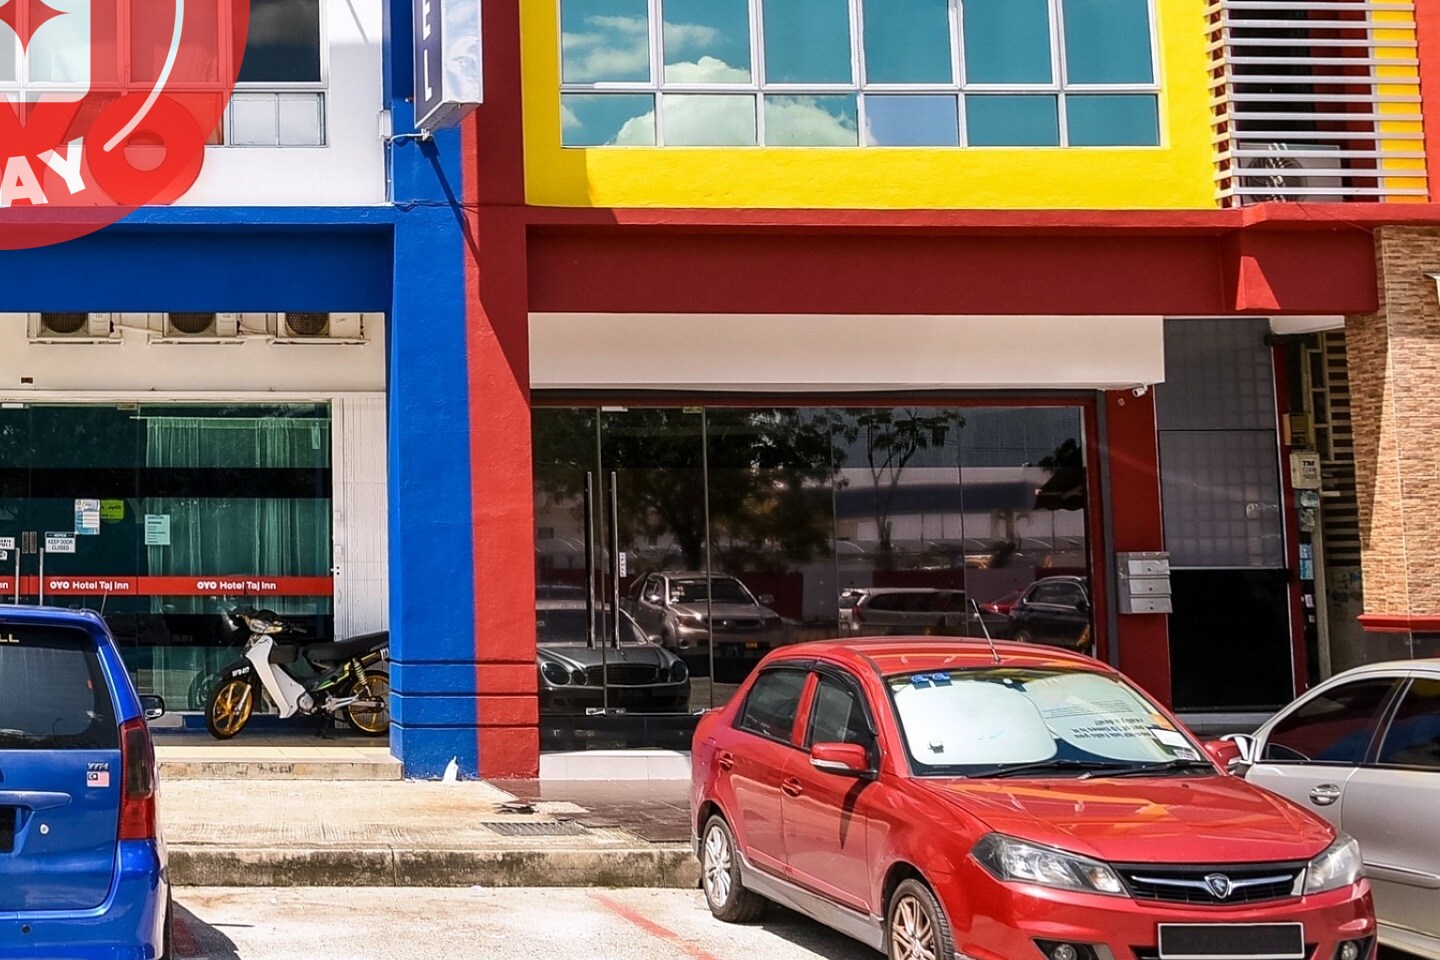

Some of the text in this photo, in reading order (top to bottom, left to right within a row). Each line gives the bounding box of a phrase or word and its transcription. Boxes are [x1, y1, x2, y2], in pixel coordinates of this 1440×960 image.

[49, 581, 129, 591] OYO Hotel Taj Inn
[196, 581, 276, 591] OYO Hotel Taj Inn
